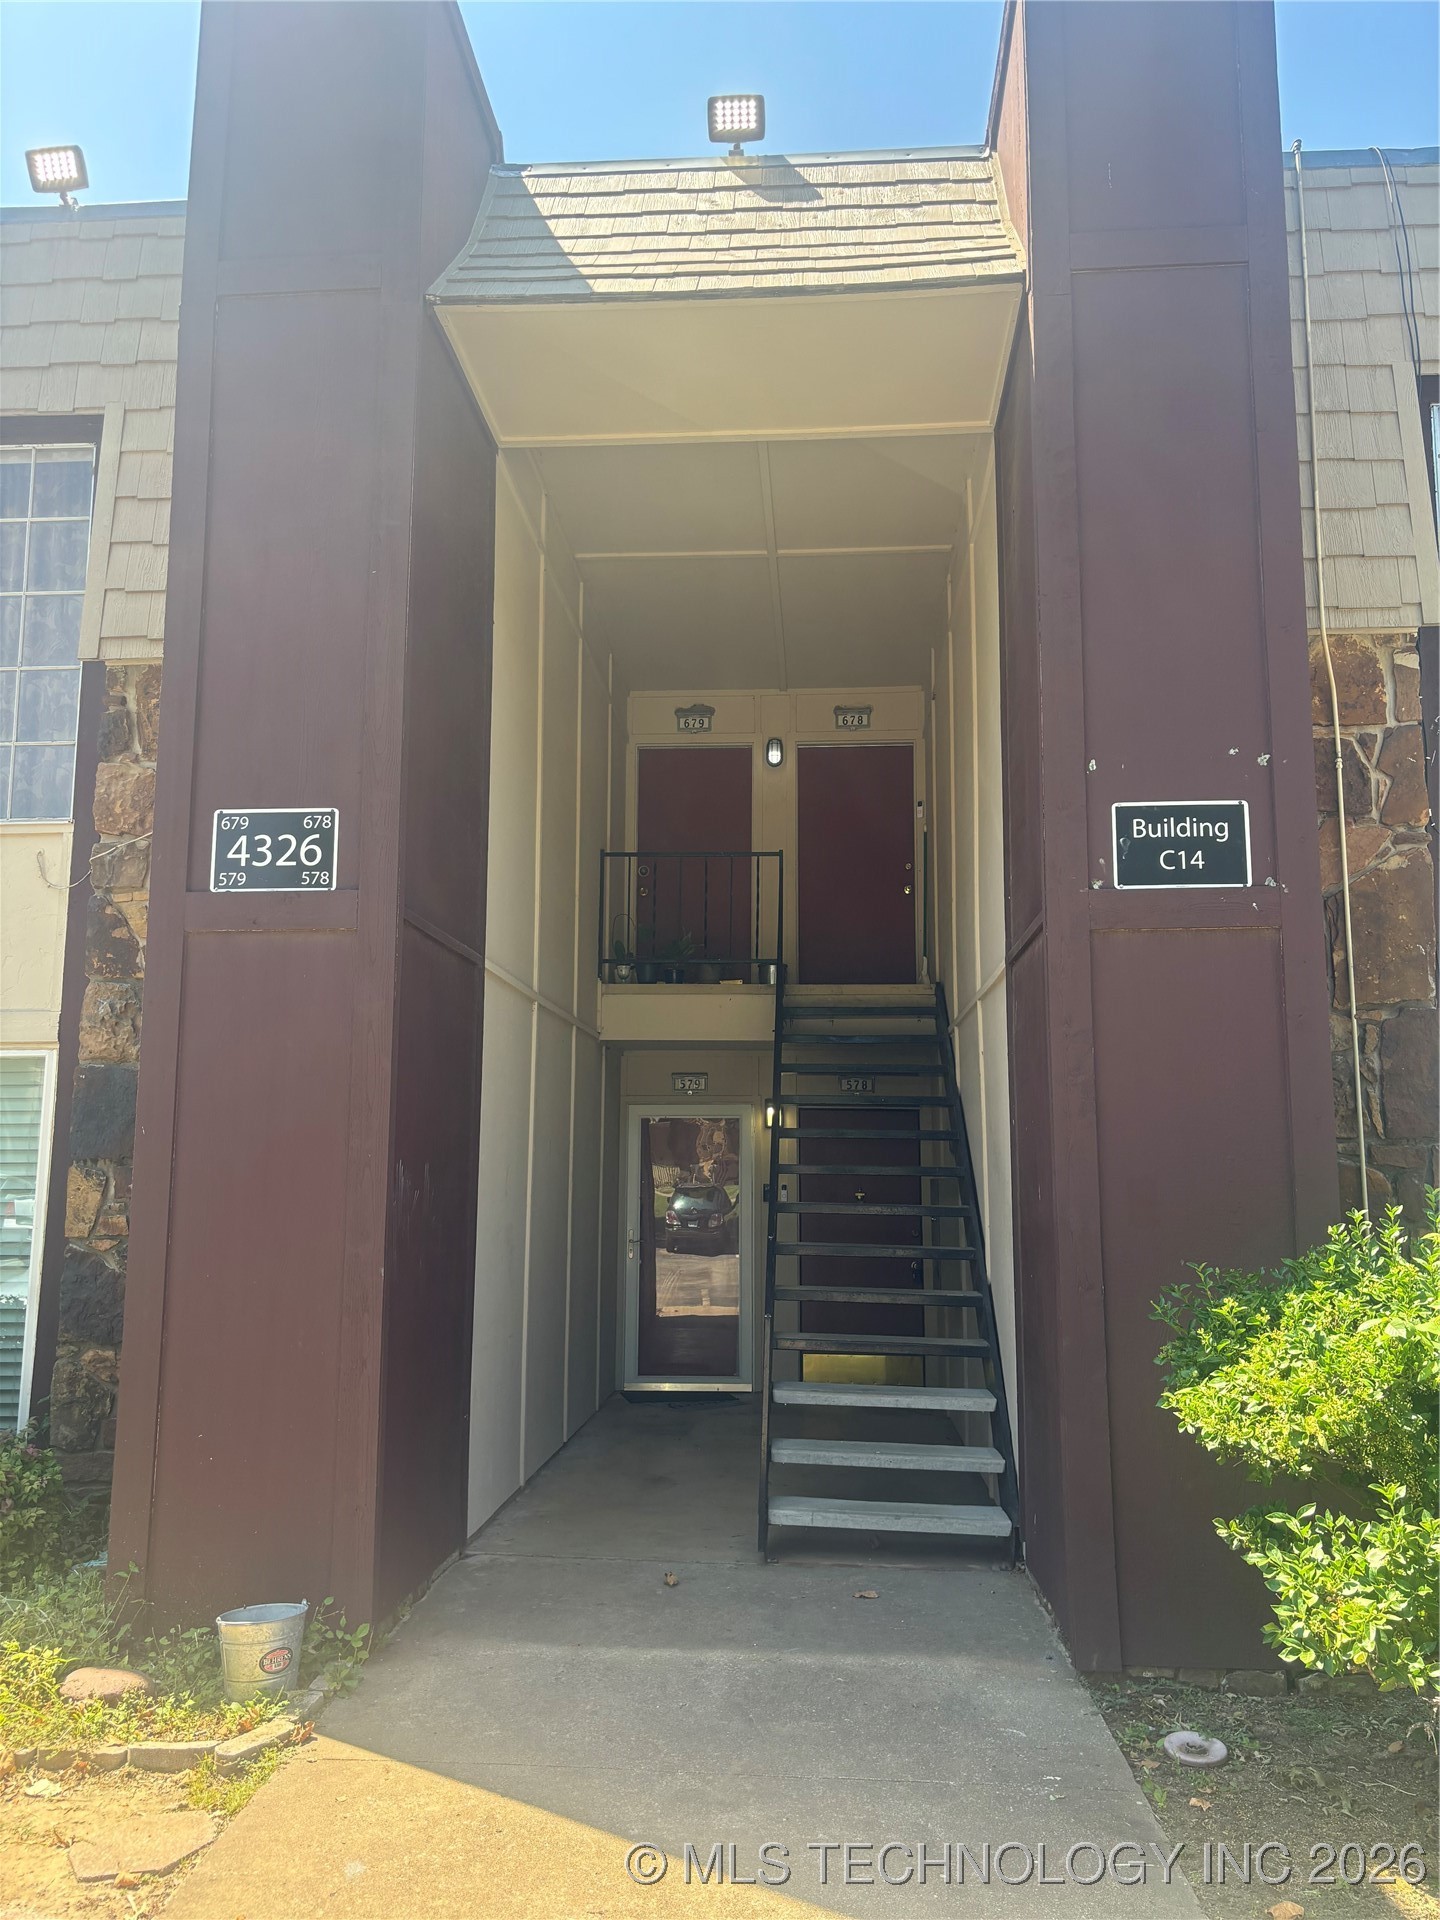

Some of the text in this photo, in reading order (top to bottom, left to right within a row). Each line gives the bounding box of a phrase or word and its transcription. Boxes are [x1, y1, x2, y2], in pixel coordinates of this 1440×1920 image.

[684, 718, 705, 729] 679
[842, 715, 863, 725] 678
[221, 815, 332, 830] 679 678
[1132, 816, 1229, 843] Building
[226, 833, 322, 867] 4326
[1159, 849, 1206, 870] C14
[218, 871, 330, 886] 579 578
[679, 1079, 701, 1089] 579
[846, 1080, 868, 1090] 578
